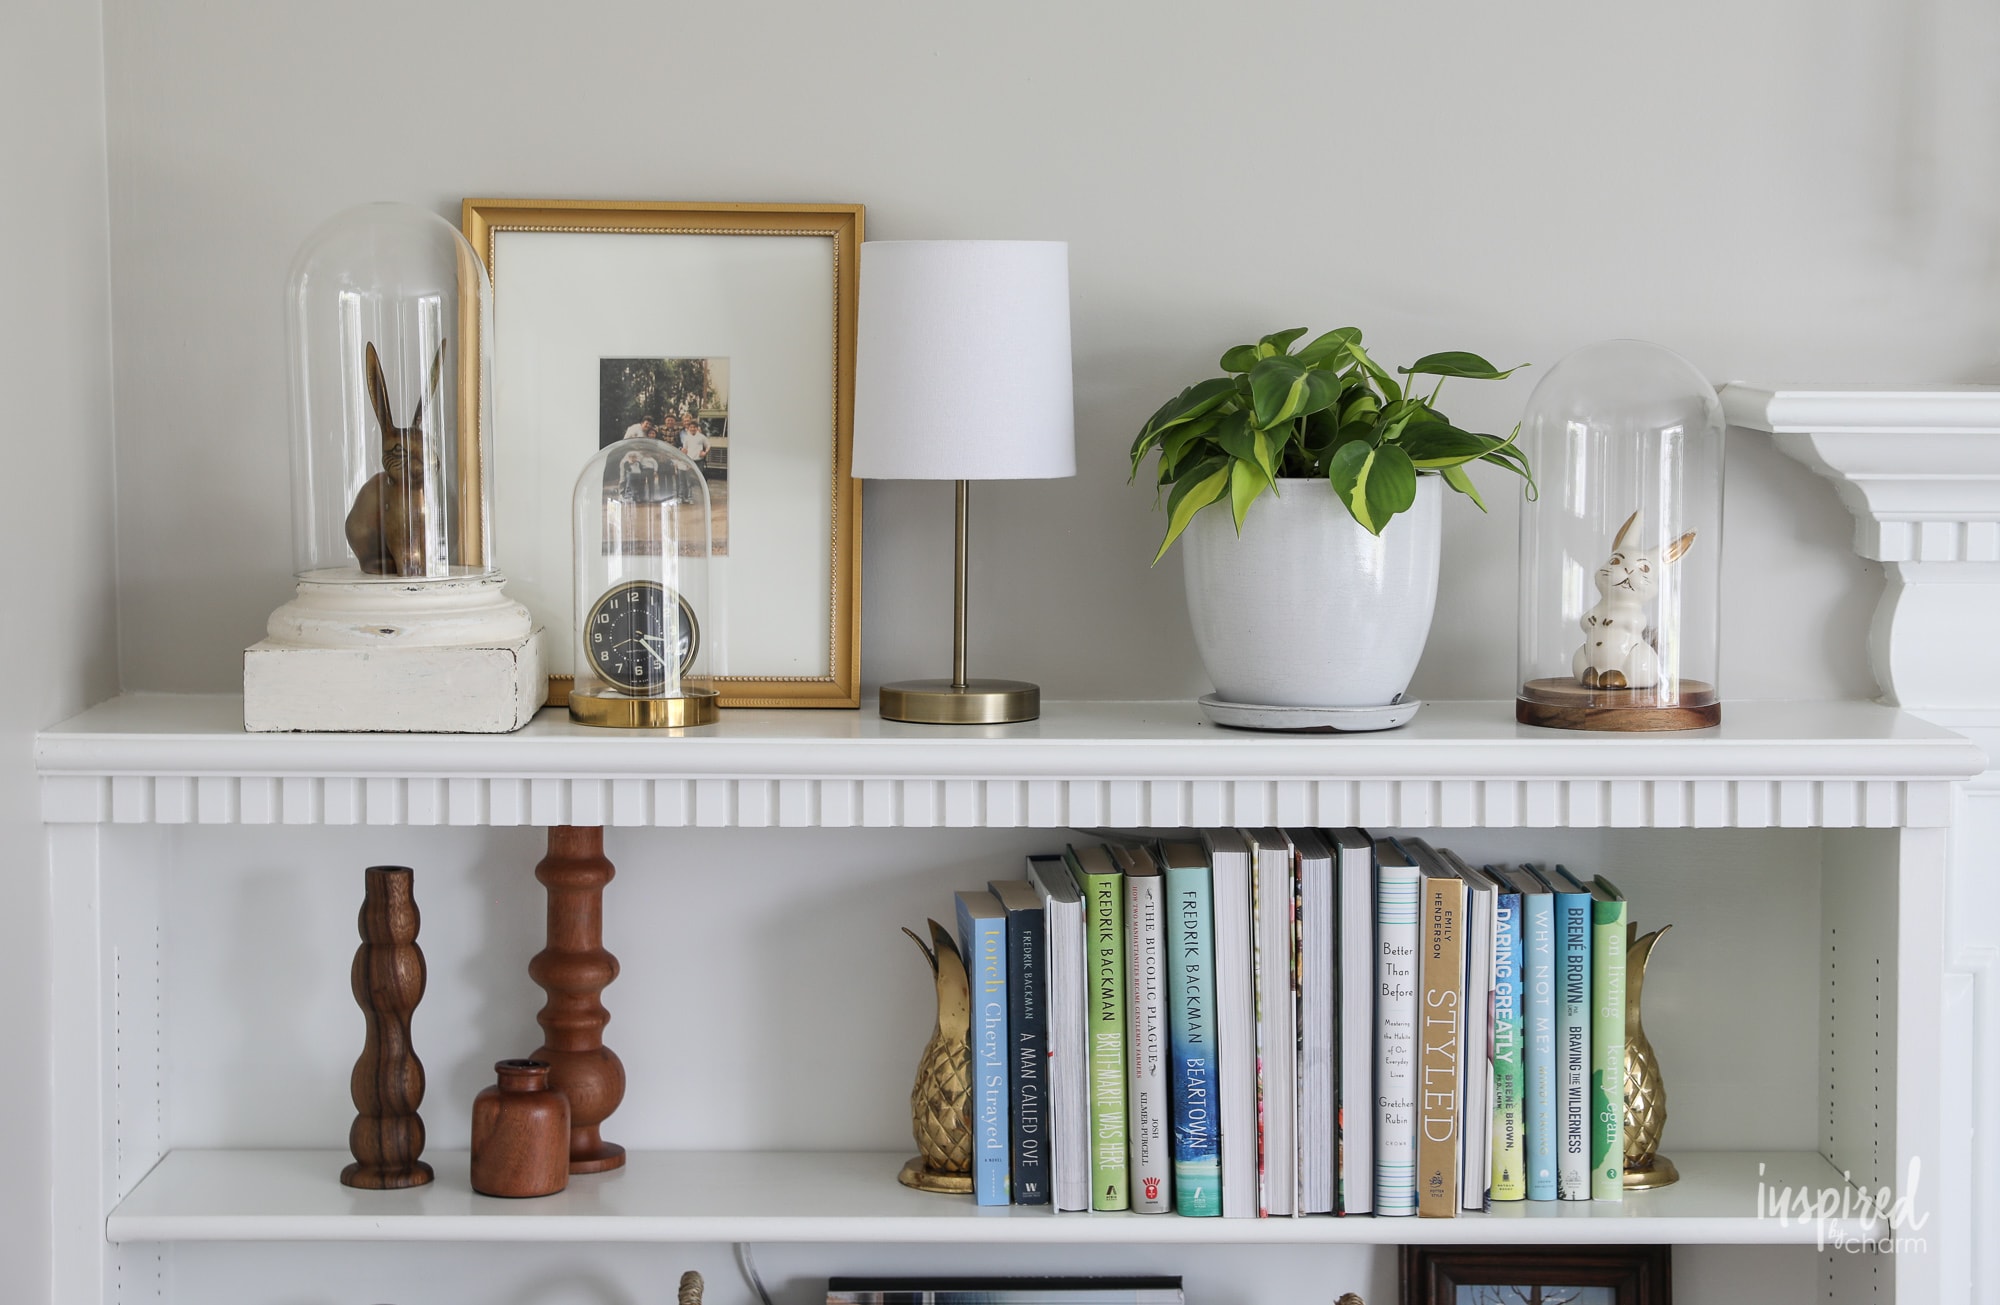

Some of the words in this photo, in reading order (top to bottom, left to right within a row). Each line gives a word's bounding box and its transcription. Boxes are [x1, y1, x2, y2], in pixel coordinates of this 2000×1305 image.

[610, 599, 618, 609] 11
[627, 592, 639, 602] 12
[594, 633, 602, 643] 9
[597, 613, 609, 624] 10
[601, 651, 609, 661] 8
[615, 663, 623, 673] 7
[635, 666, 643, 676] 6
[653, 660, 662, 670] 5
[1098, 882, 1113, 943] FREDRIK
[1145, 902, 1154, 931] THE
[1183, 891, 1199, 958] FREDRIK
[1434, 892, 1443, 960] HENDERSON
[1444, 911, 1452, 942] EMILY
[1535, 910, 1548, 954] WHY
[1568, 908, 1586, 951] BRENÉ
[985, 931, 1005, 993] torch
[1023, 930, 1033, 970] FREDRIK
[1383, 942, 1413, 955] Better
[1496, 908, 1512, 978] DARING
[1608, 935, 1620, 956] on
[1100, 949, 1115, 1021] BACKMAN
[1146, 938, 1156, 1000] BUCOLIC
[1386, 963, 1409, 975] Than
[1535, 966, 1549, 1006] NOT
[1567, 955, 1583, 1003] BROWN
[1024, 973, 1034, 1019] BACKMAN
[1186, 965, 1202, 1044] BACKMAN
[1382, 983, 1413, 1001] Before
[1601, 966, 1624, 1018] living
[980, 1002, 1002, 1067] Cheryl
[1020, 1033, 1036, 1042] A
[1147, 1006, 1158, 1063] PLAGUE
[1384, 1019, 1410, 1027] Mastering
[1495, 983, 1513, 1064] GREATLY
[1536, 1017, 1550, 1053] ME?
[1020, 1048, 1037, 1079] MAN
[1386, 1057, 1408, 1066] Everyday
[1424, 988, 1457, 1142] STYLED
[1568, 1026, 1582, 1071] BRAVING
[1096, 1032, 1121, 1107] BRITT-MARIE
[1572, 1073, 1580, 1084] THE
[1600, 1044, 1624, 1095] kerry
[981, 1075, 1003, 1149] Strayed
[1021, 1084, 1038, 1134] CALLED
[1186, 1058, 1208, 1149] BEARTOWN
[1379, 1096, 1414, 1108] Gretchen
[1385, 1113, 1407, 1124] Rubin
[1568, 1087, 1582, 1154] WILDERNESS
[1099, 1111, 1125, 1139] WAS
[1140, 1092, 1149, 1166] KILMER-PURCELL
[1505, 1113, 1514, 1151] BROWN,
[1600, 1102, 1618, 1144] egan
[1022, 1139, 1039, 1167] OVE
[1099, 1142, 1125, 1170] HERE
